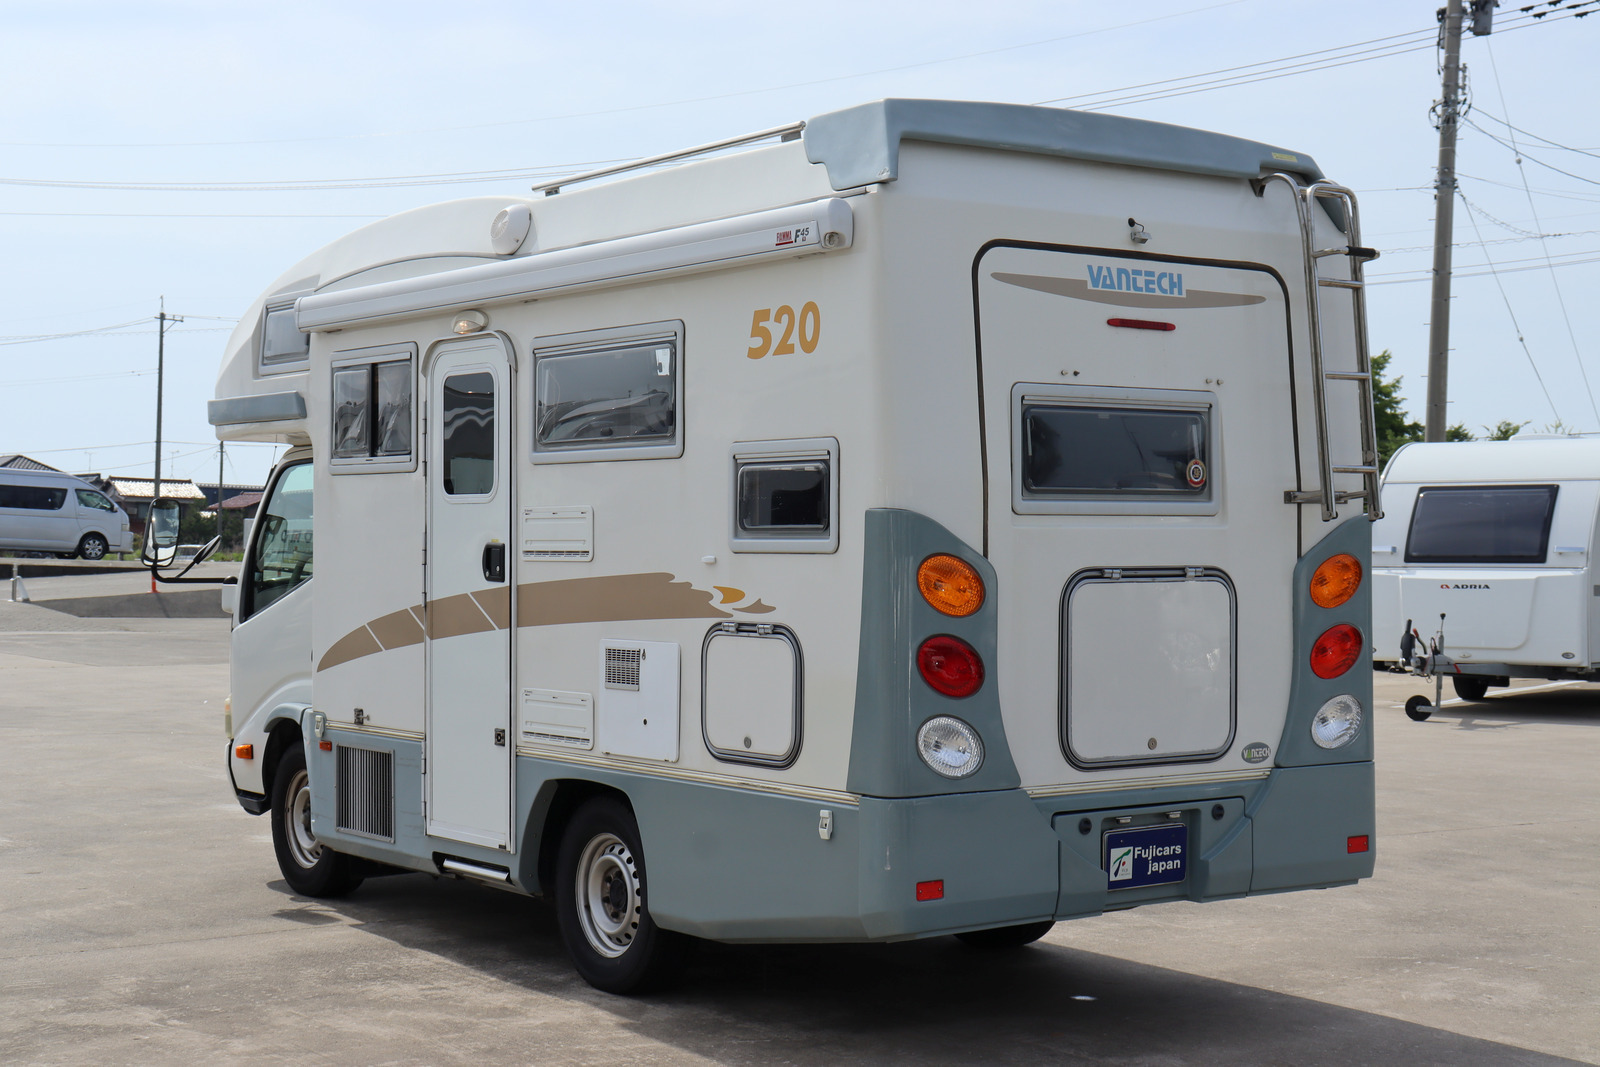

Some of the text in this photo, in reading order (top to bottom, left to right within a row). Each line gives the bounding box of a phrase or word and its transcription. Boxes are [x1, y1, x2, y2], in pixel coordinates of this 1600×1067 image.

[1087, 264, 1183, 296] VANTECH
[747, 301, 820, 360] 520
[1134, 845, 1182, 860] Fujicars
[1147, 859, 1181, 875] japan
